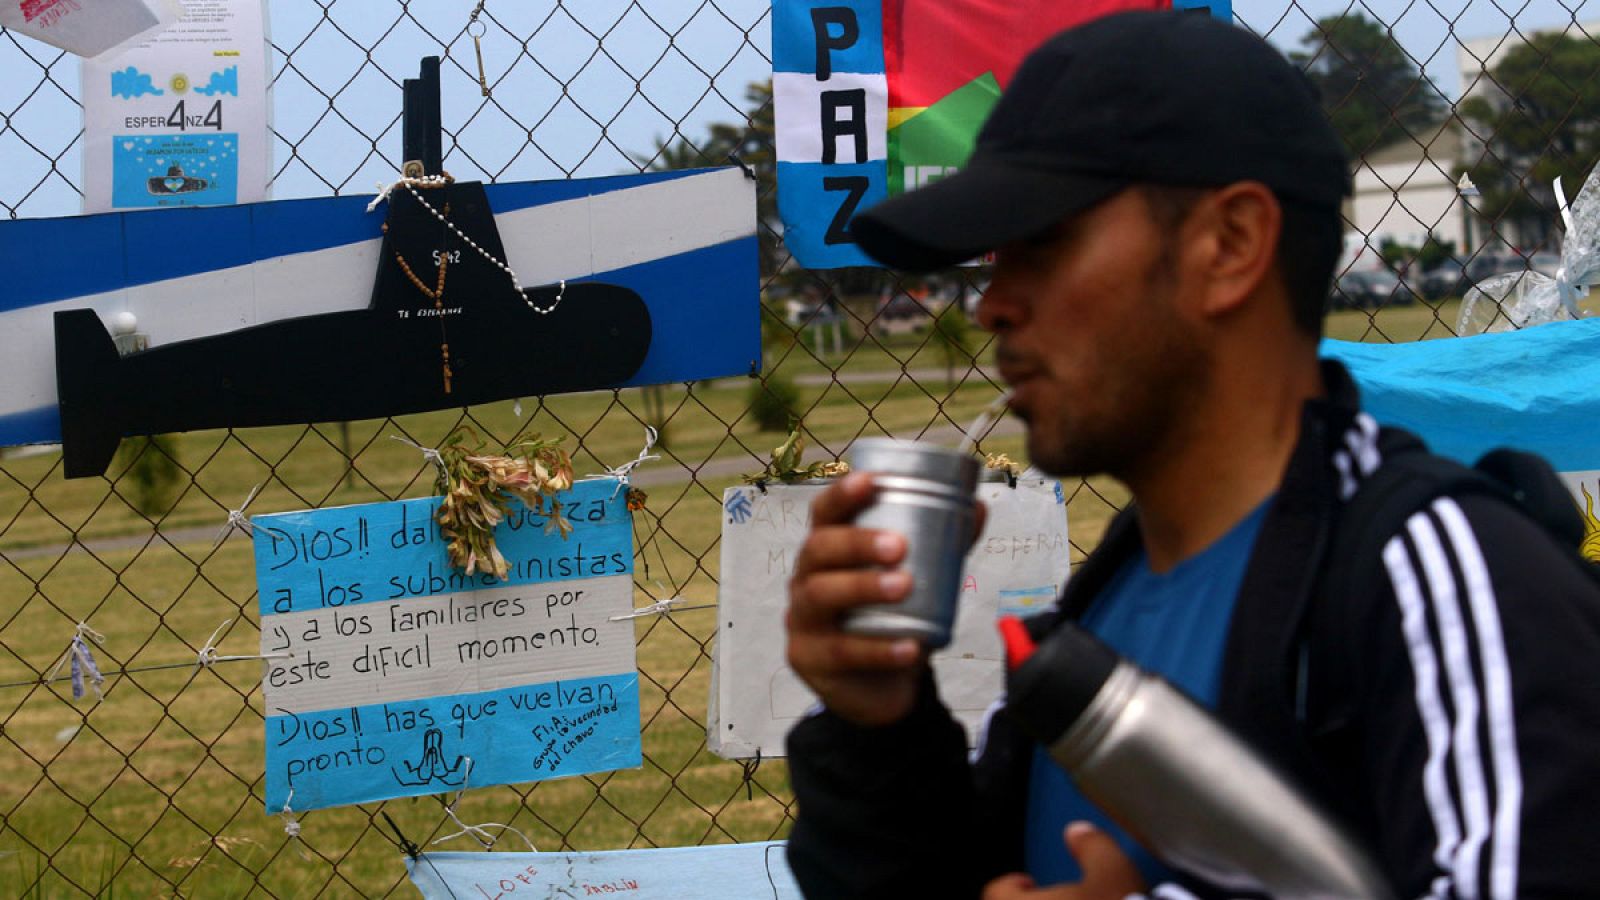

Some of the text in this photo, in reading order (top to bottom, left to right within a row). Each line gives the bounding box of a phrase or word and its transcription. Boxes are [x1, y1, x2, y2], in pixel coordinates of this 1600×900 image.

[125, 99, 222, 131] ESPER4NZ4
[810, 6, 870, 246] PAZ
[273, 543, 628, 614] a los submainistas
[269, 650, 332, 688] este
[457, 612, 601, 664] momento.
[271, 625, 292, 652] y
[302, 619, 322, 642] a
[334, 611, 373, 637] los
[546, 589, 584, 619] por
[383, 703, 436, 734] has
[451, 699, 499, 740] que
[508, 680, 614, 711] vuelvan
[287, 737, 387, 787] pronto
